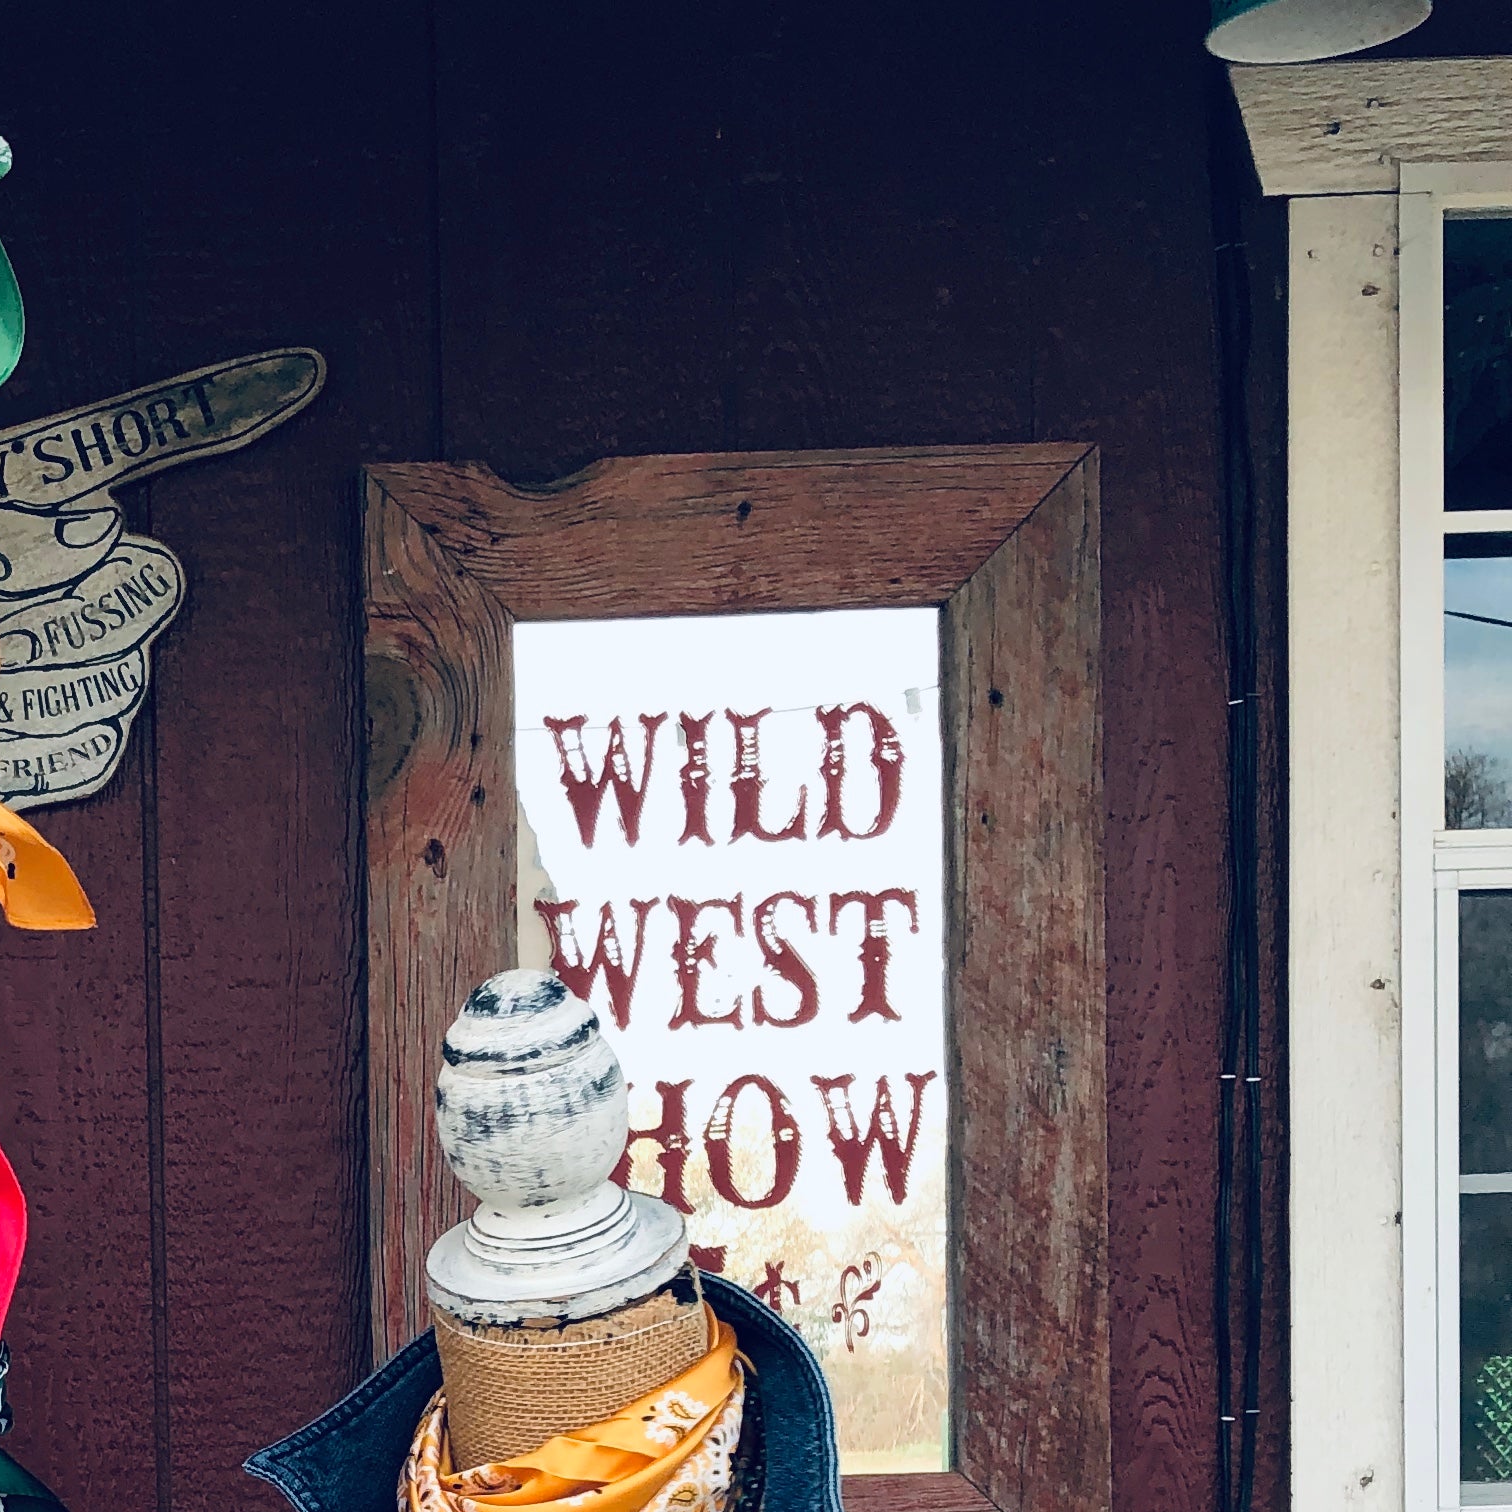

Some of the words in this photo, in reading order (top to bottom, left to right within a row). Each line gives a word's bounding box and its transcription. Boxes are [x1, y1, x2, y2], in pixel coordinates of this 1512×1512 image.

[42, 562, 172, 657] FUSSING
[22, 661, 141, 721] FIGHTING
[543, 701, 906, 850] WILD
[533, 887, 920, 1032] WEST
[608, 1070, 937, 1214] HOW
